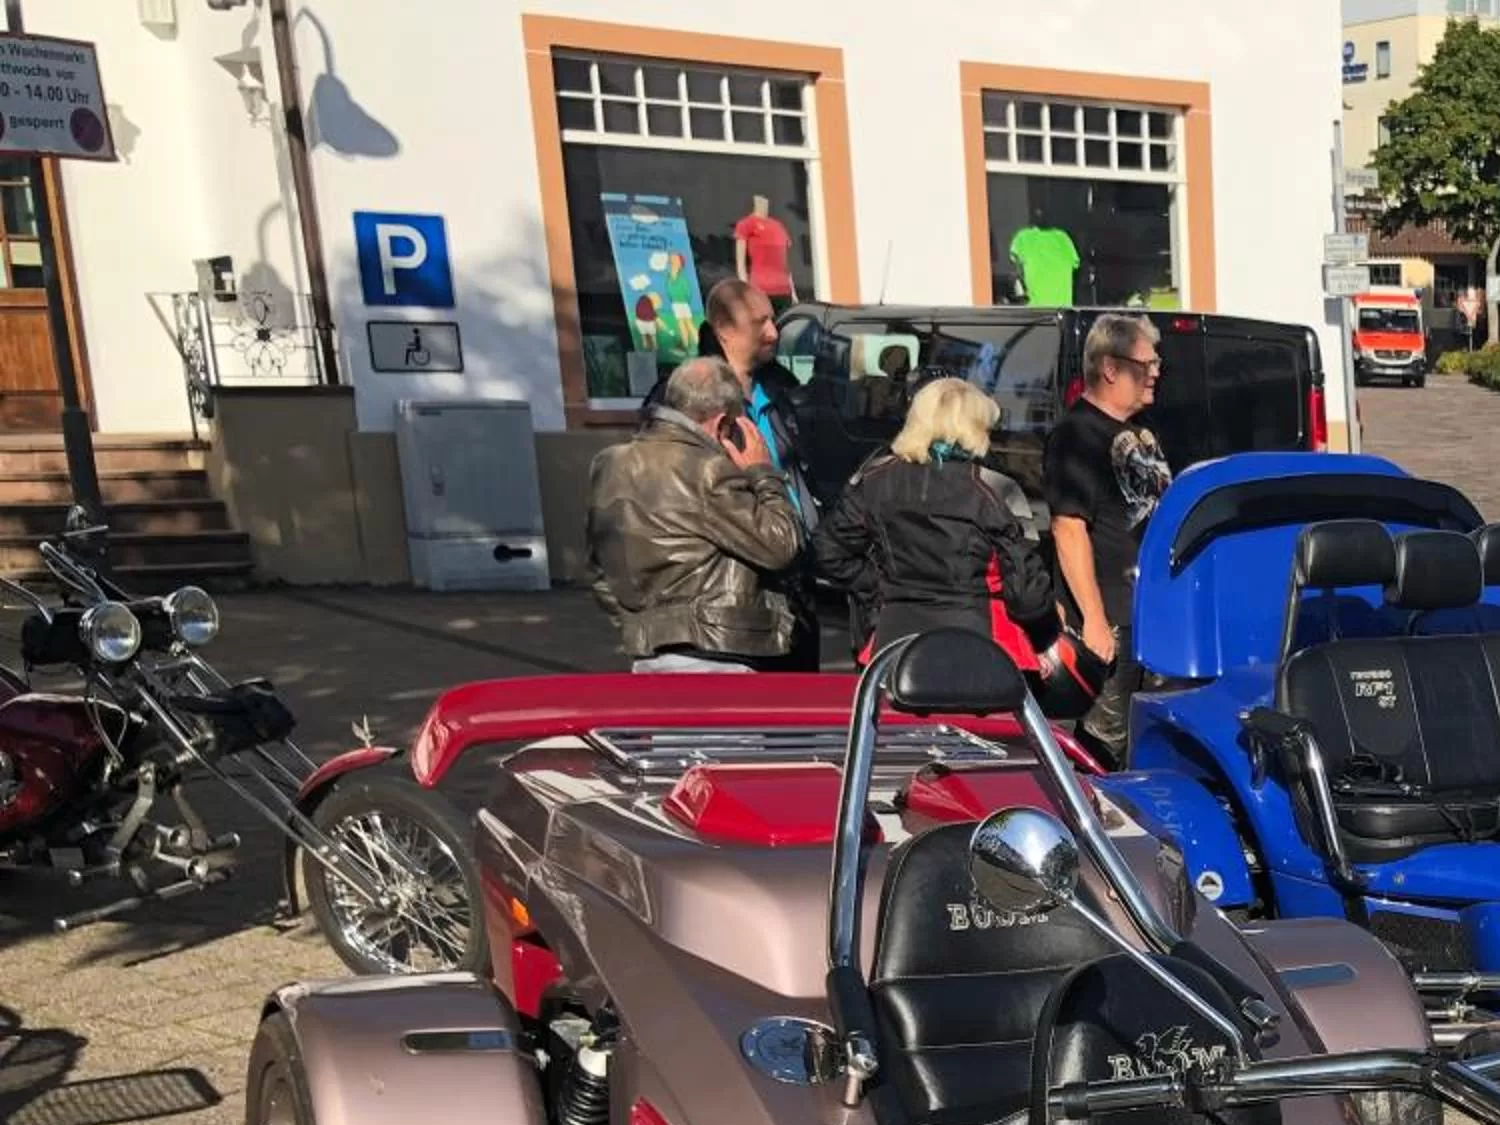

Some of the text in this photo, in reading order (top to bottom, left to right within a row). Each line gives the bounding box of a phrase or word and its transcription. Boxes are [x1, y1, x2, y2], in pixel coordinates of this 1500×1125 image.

[0, 63, 51, 78] ttwochs
[25, 83, 63, 103] 14.00
[66, 87, 89, 104] Uhr
[9, 115, 64, 131] gesperrt
[375, 223, 428, 296] P
